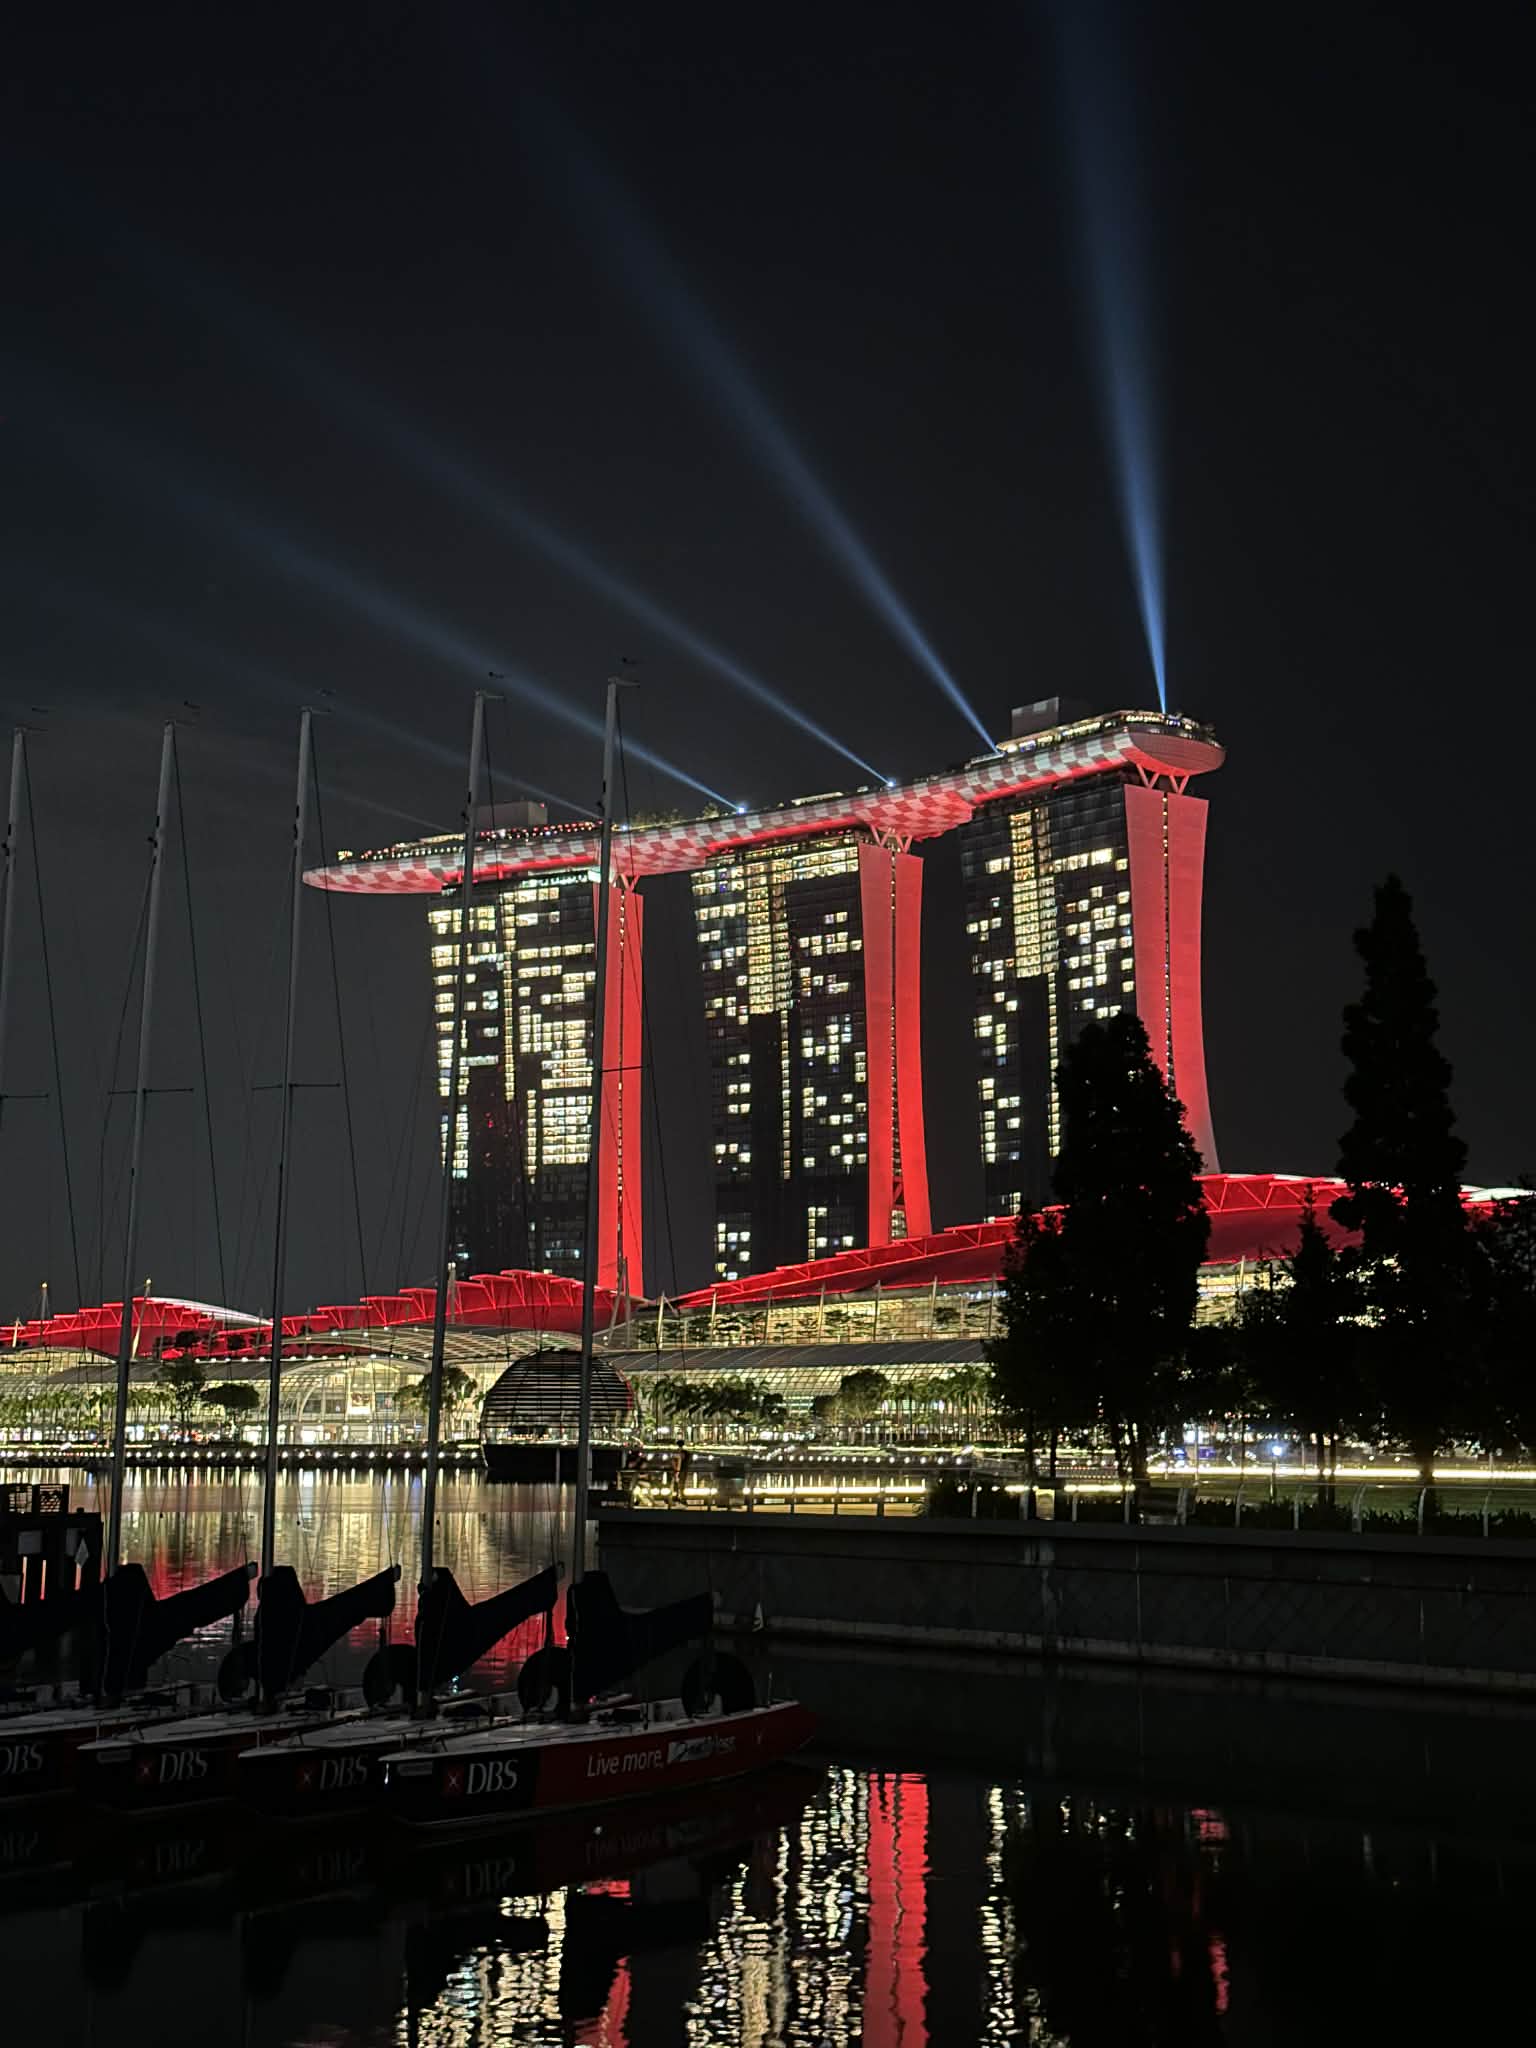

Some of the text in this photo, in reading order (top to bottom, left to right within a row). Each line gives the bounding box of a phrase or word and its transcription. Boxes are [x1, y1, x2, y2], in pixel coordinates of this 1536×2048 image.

[157, 1750, 209, 1784] DBS
[319, 1753, 369, 1791] DBS
[465, 1758, 519, 1795] DBS
[586, 1752, 620, 1777] Live
